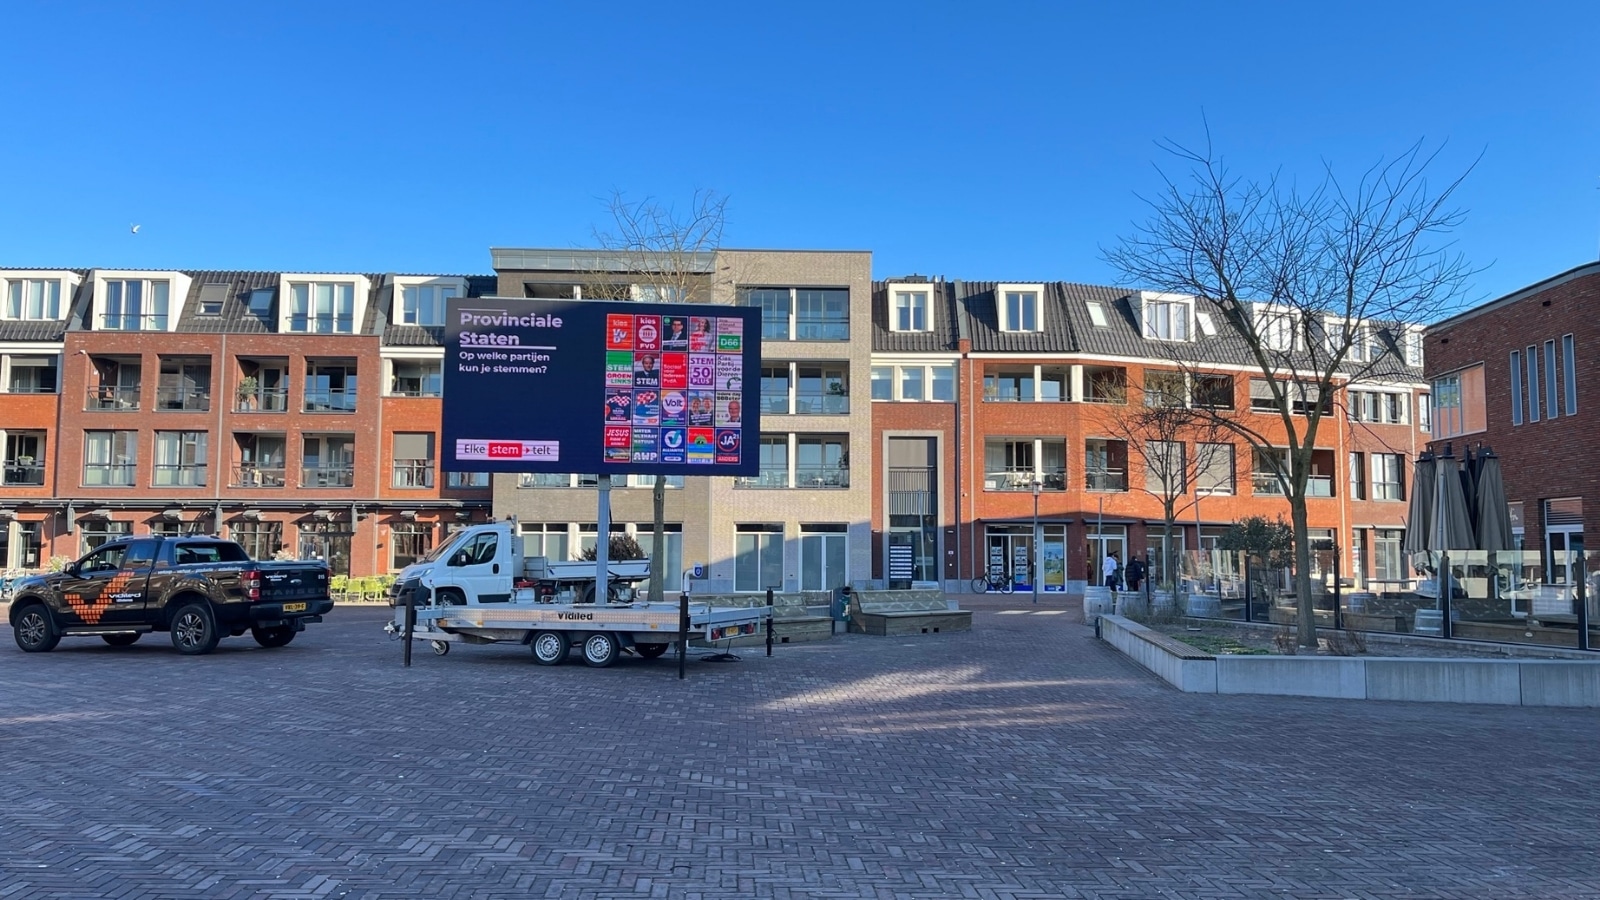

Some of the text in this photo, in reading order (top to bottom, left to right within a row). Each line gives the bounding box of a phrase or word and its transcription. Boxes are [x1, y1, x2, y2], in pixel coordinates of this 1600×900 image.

[460, 312, 562, 328] Provinciale
[459, 331, 519, 345] Staten
[459, 351, 550, 362] Op welke partijen
[459, 364, 547, 374] kun je stemmen?
[692, 368, 710, 378] 50
[464, 444, 550, 454] Elke stem telt
[634, 452, 657, 460] AWP
[262, 588, 326, 596] RANGER
